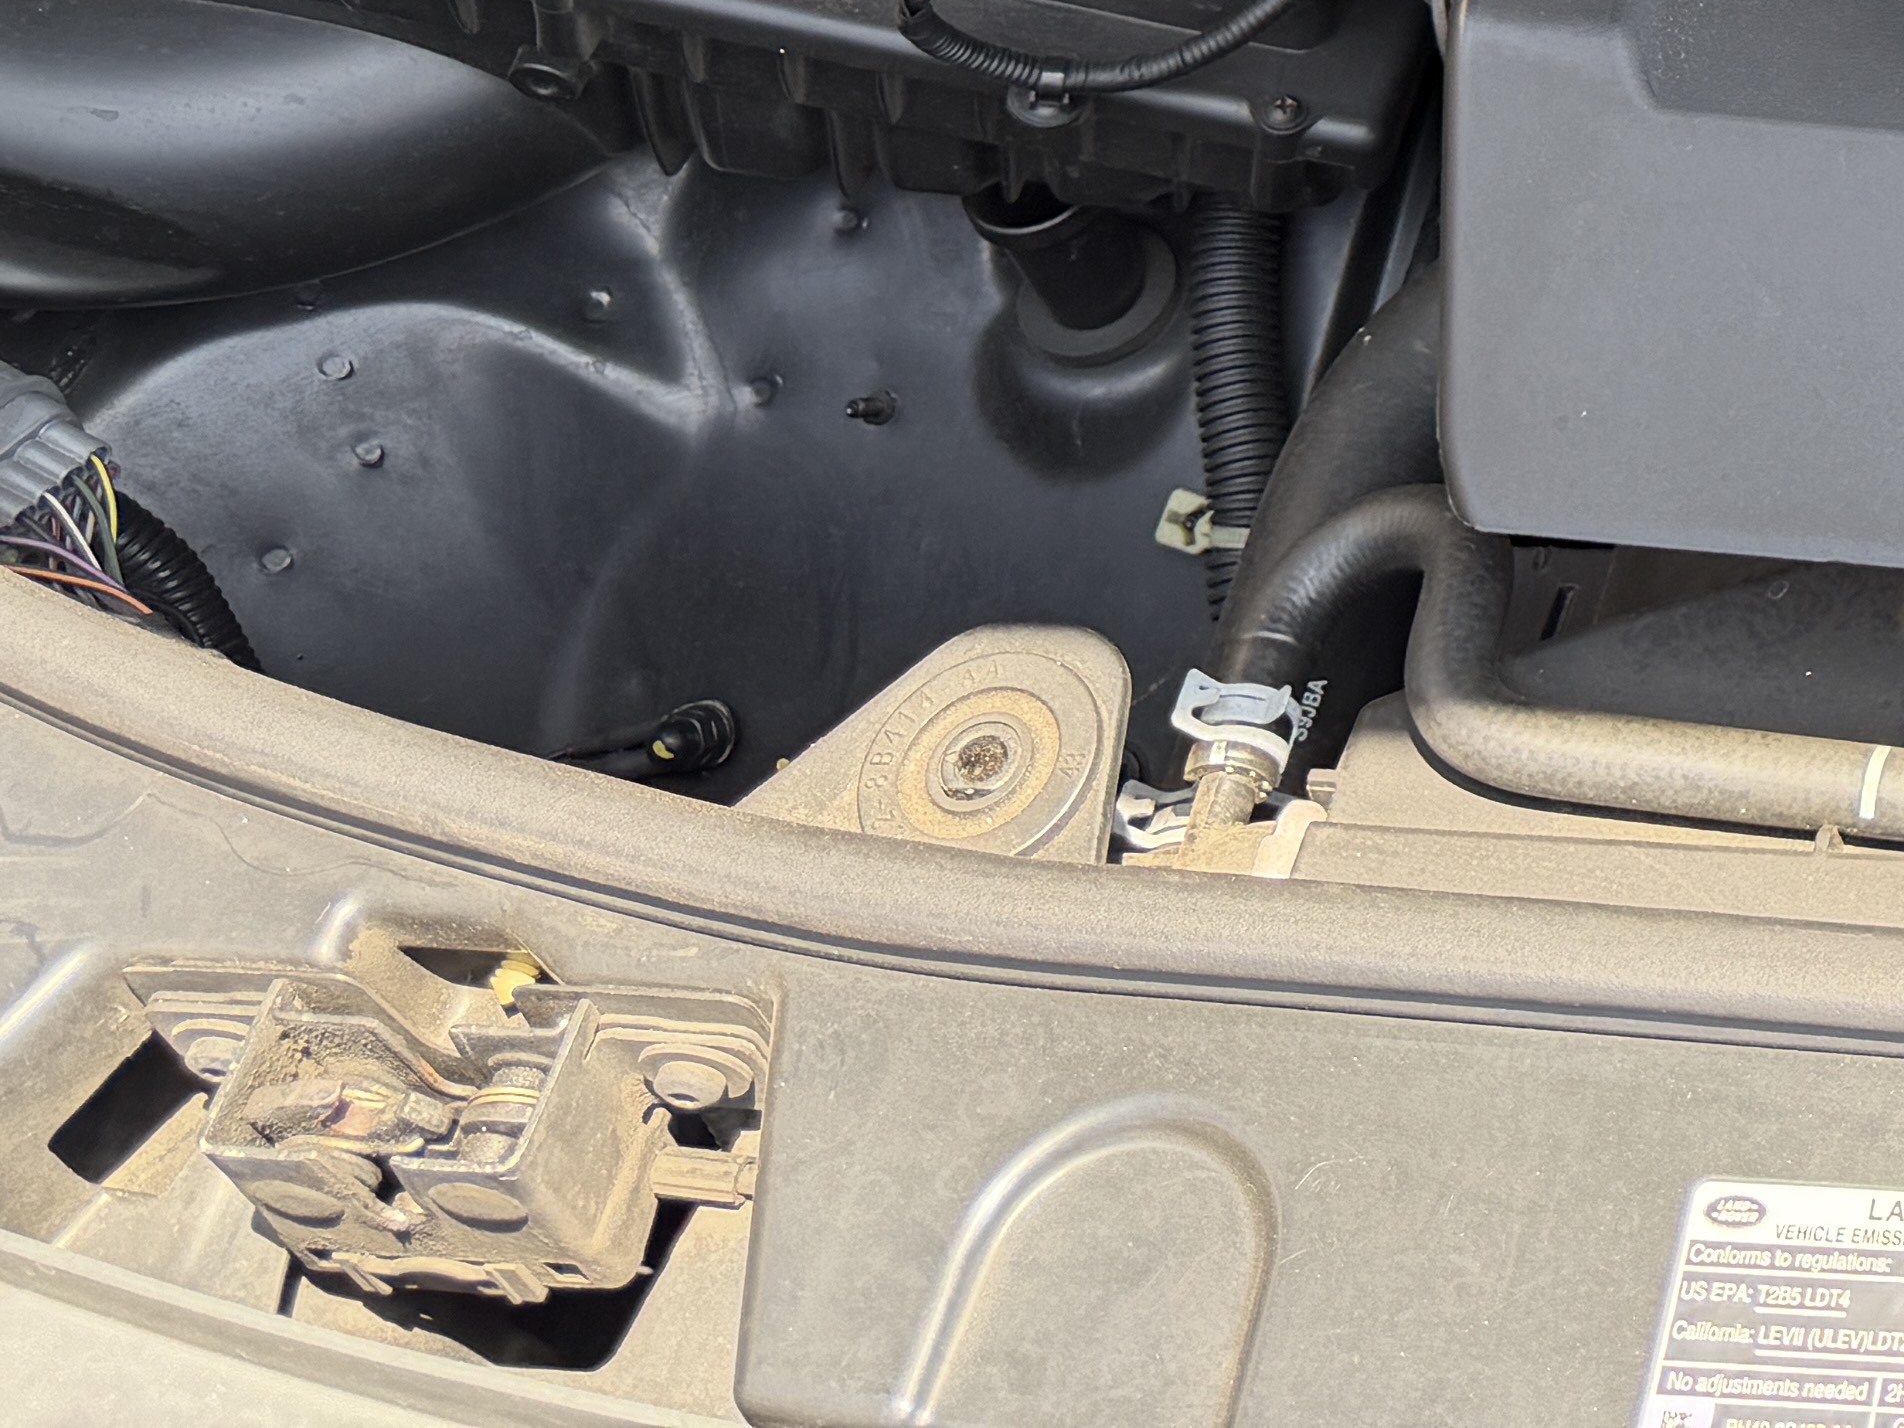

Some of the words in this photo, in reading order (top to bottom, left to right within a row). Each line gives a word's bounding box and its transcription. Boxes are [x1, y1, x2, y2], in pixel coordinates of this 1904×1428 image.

[1776, 1224, 1847, 1244] VEHICLE
[1689, 1243, 1772, 1267] Conforms
[1774, 1248, 1792, 1268] to
[1795, 1251, 1894, 1274] regulations:
[1681, 1280, 1708, 1302] US
[1710, 1282, 1755, 1304] EPA:
[1757, 1284, 1802, 1307] T2B5
[1804, 1286, 1851, 1309] LDT4
[1672, 1319, 1756, 1344] California:
[1666, 1371, 1693, 1392] No
[1695, 1373, 1800, 1398] adjustments
[1802, 1380, 1869, 1403] needed
